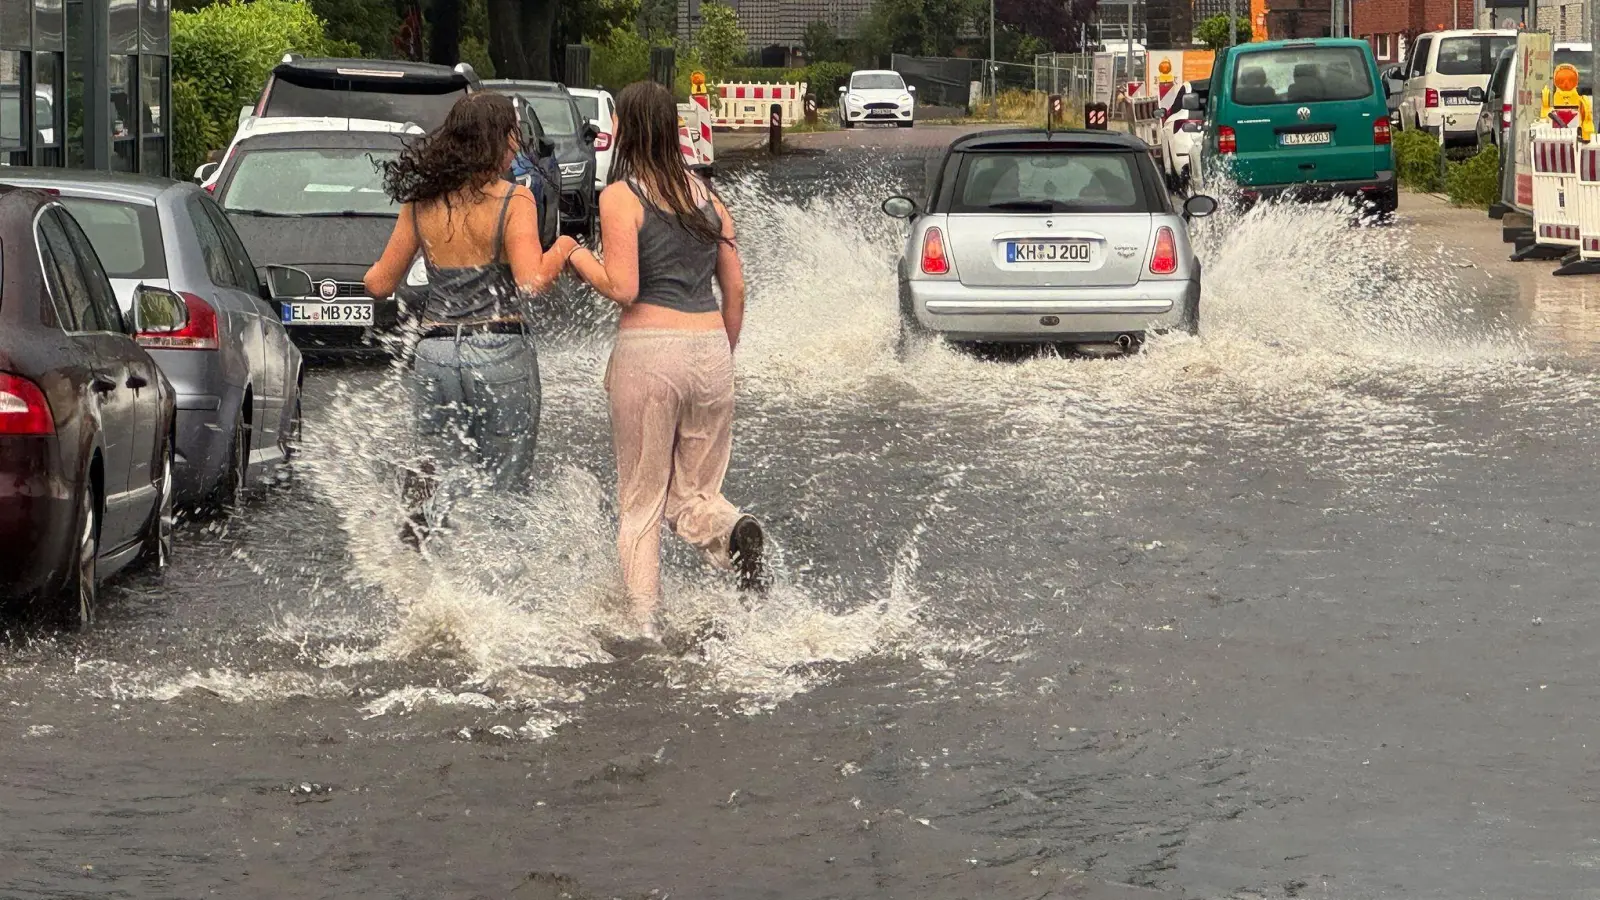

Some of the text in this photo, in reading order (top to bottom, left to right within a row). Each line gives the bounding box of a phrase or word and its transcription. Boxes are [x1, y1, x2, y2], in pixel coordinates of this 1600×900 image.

[1308, 132, 1329, 142] 2003
[1016, 245, 1089, 260] KH J 200
[292, 305, 371, 320] EL MB 933
